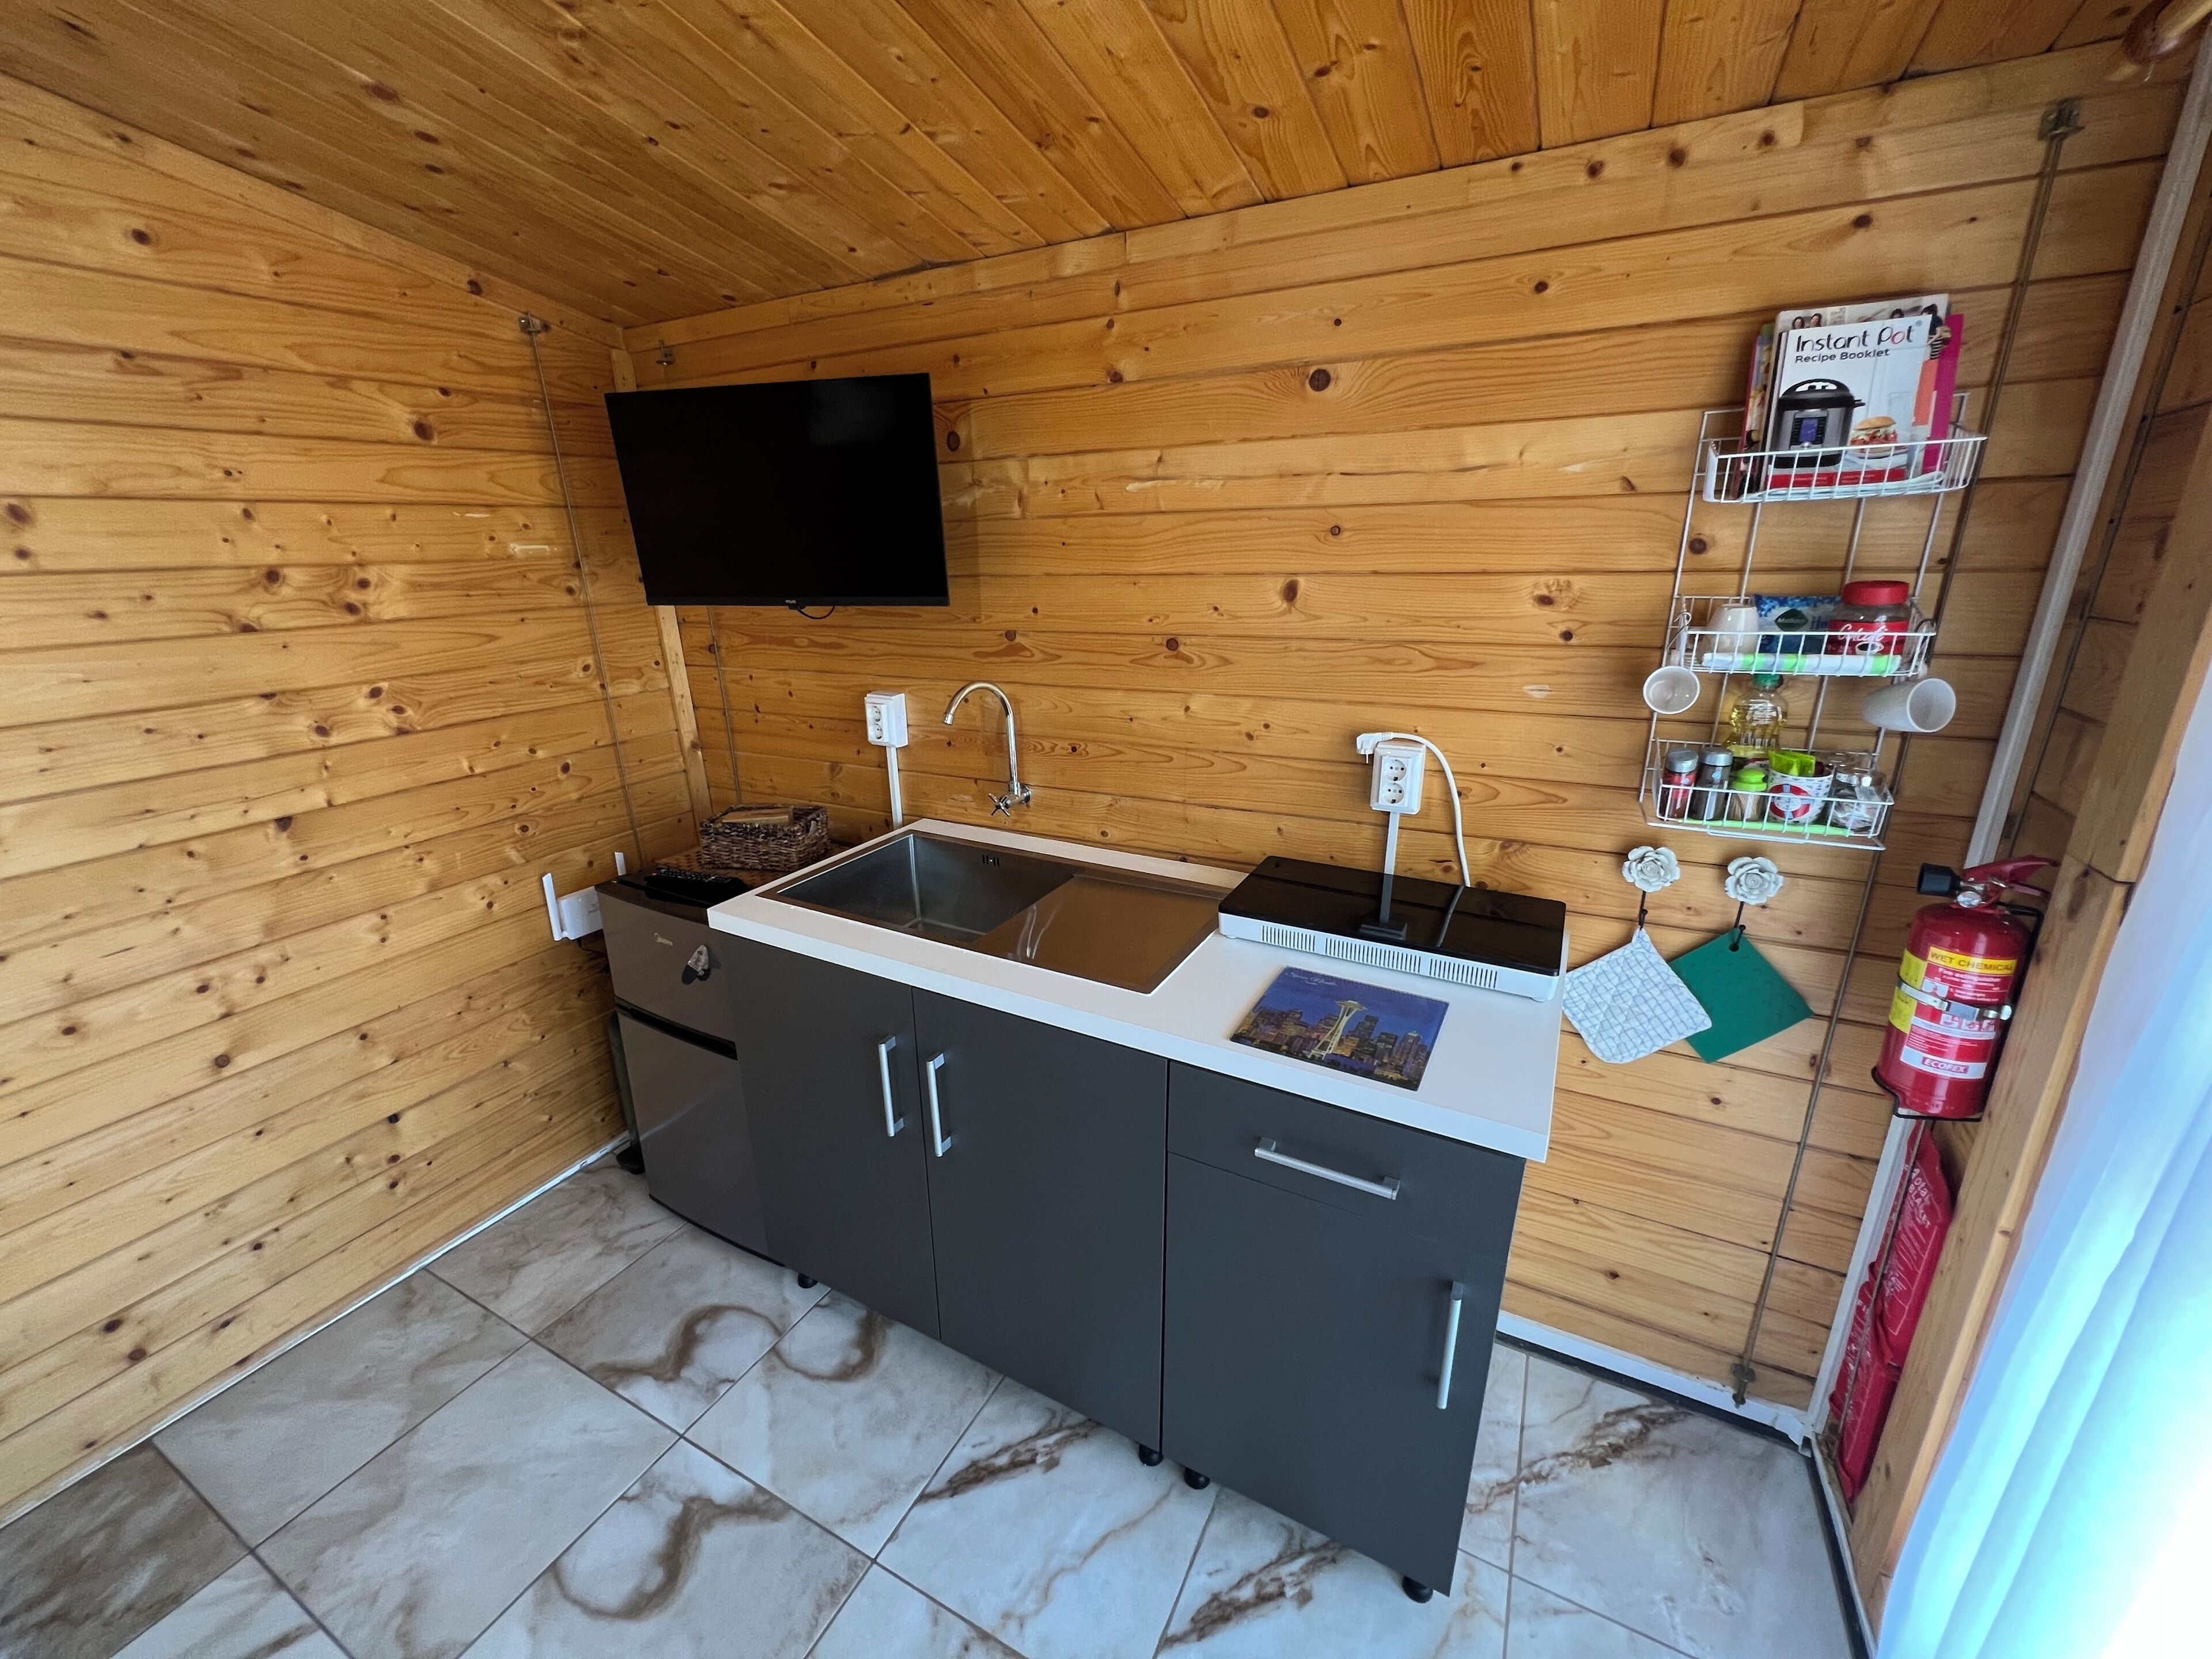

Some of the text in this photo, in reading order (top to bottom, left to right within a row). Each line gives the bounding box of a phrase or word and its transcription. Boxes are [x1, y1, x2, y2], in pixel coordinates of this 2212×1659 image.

[1796, 325, 1914, 352] Instant Pot
[1795, 349, 1890, 364] Recipe Booklet
[1930, 951, 2013, 971] WET CHEMICAL
[1924, 1059, 1966, 1073] ECOFEX
